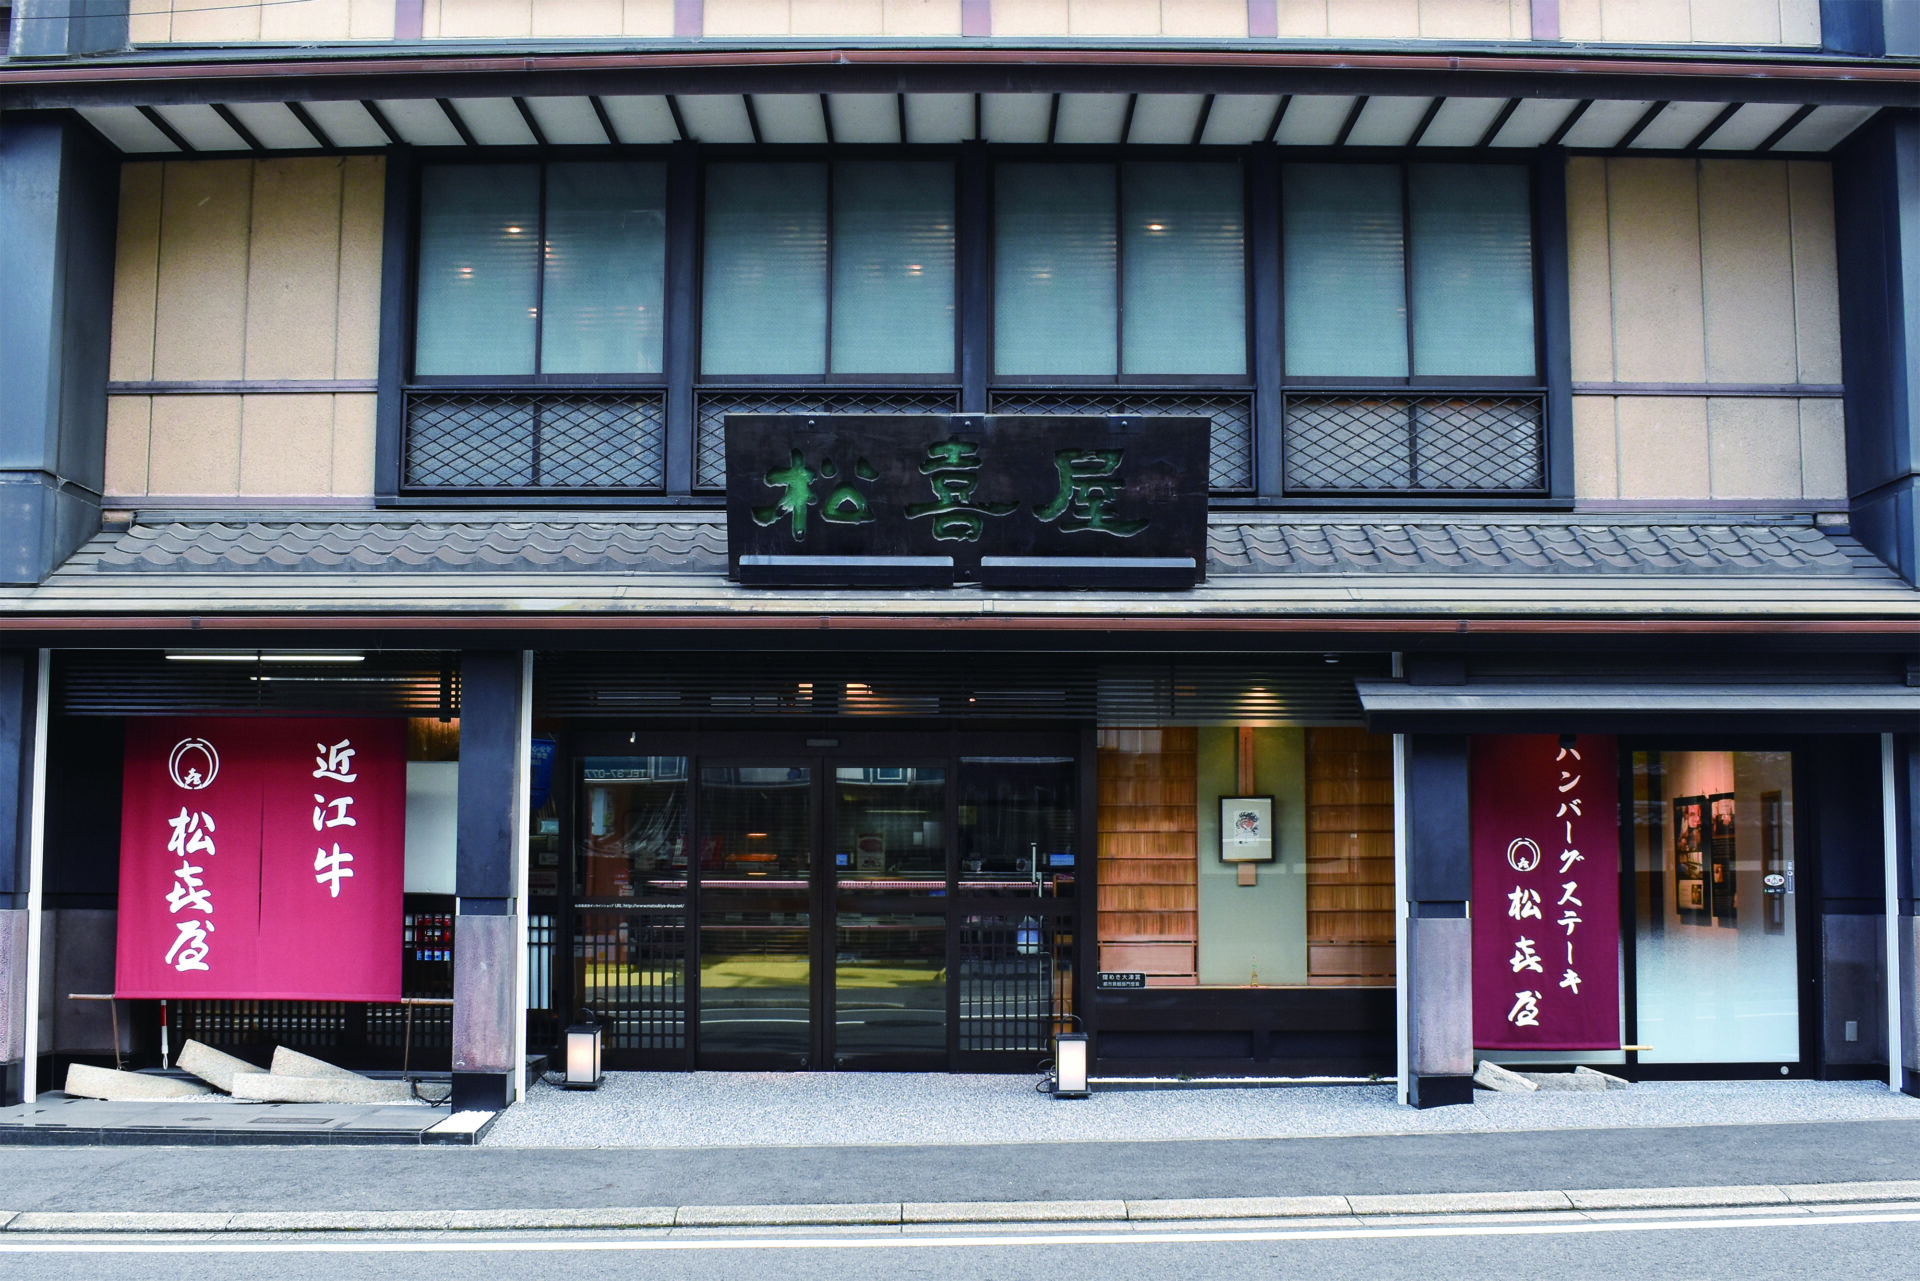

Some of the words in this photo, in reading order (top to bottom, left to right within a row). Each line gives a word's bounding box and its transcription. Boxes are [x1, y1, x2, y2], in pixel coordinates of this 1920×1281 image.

[751, 435, 1150, 542] 松喜屋
[312, 738, 359, 898] 近江牛
[1556, 747, 1585, 995] ハンバーグステーキ
